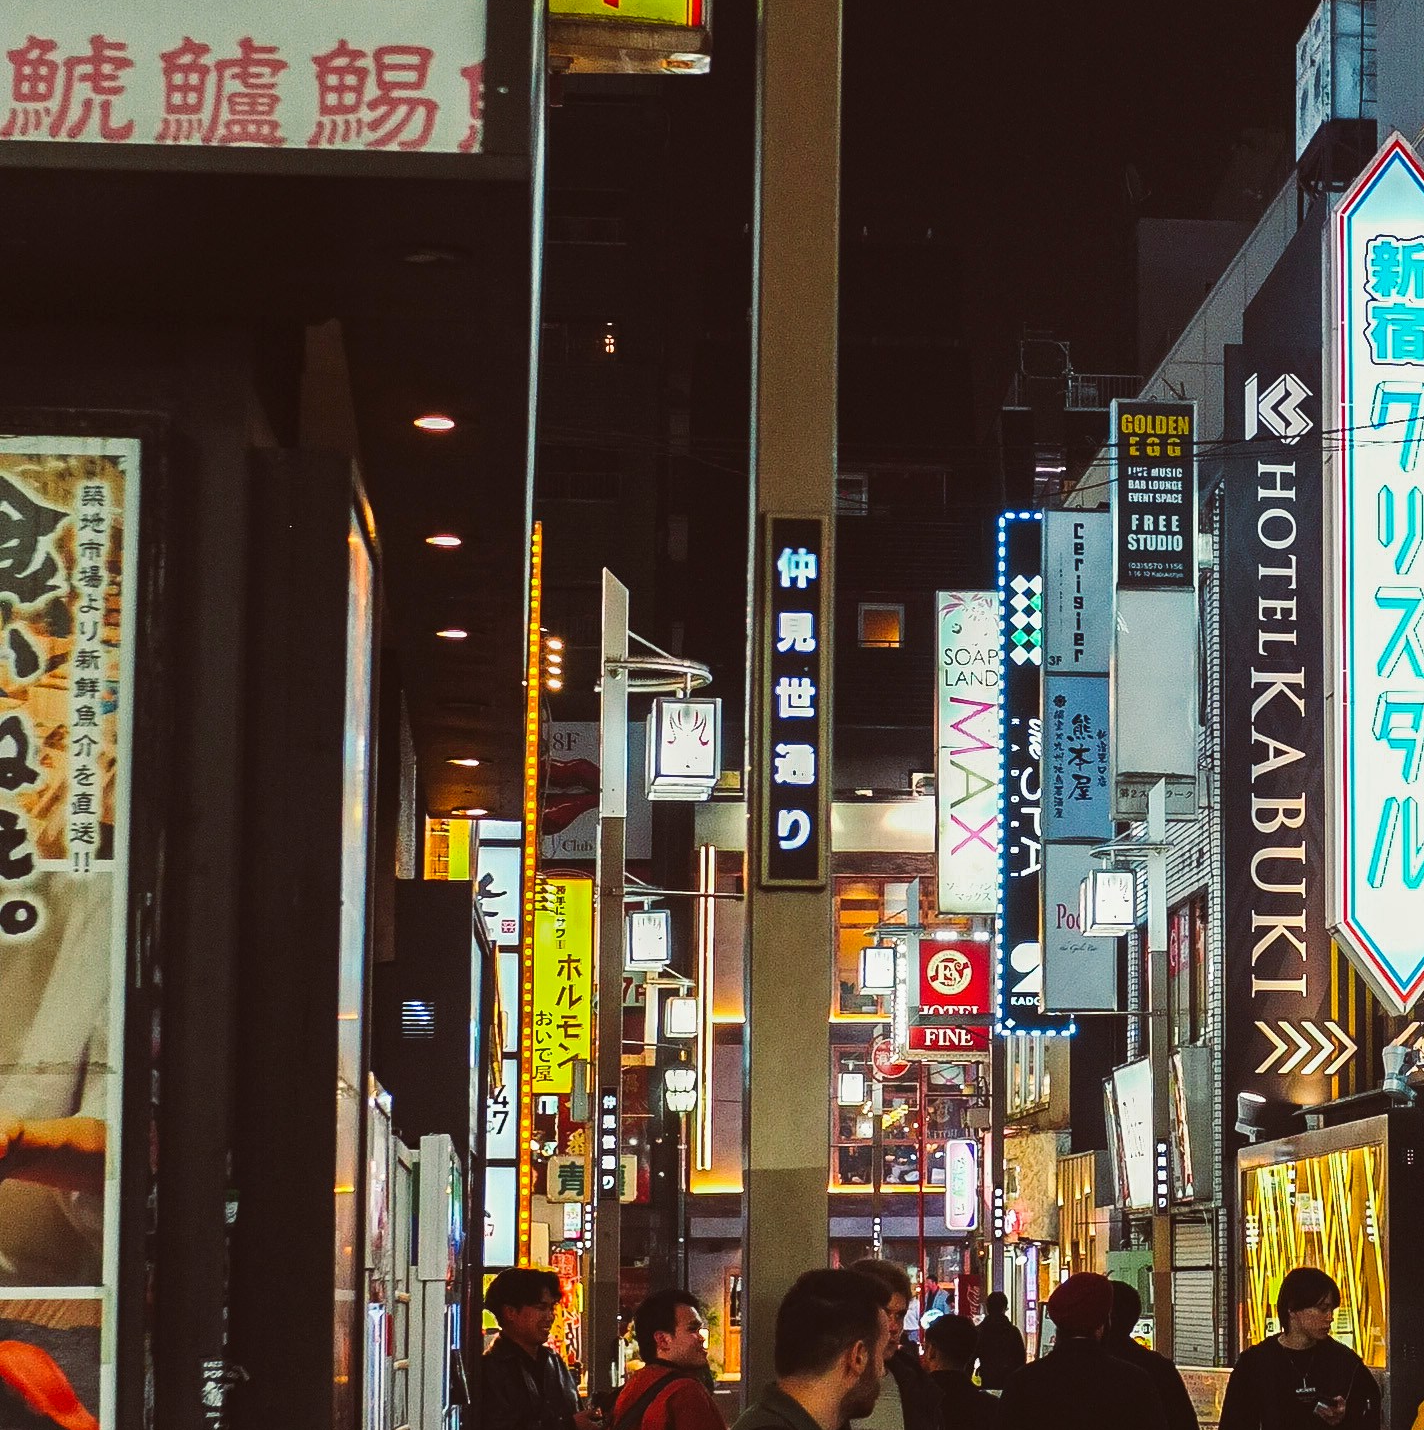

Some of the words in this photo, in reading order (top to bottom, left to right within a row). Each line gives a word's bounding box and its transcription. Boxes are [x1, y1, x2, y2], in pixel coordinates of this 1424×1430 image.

[1121, 414, 1190, 435] GOLDEN
[1129, 437, 1182, 457] EGG
[1151, 466, 1183, 478] MUSIC
[1149, 479, 1183, 491] LOUNGE
[1128, 492, 1153, 503] EVENT
[1155, 492, 1183, 503] SPACE
[1131, 514, 1180, 531] FREE
[1127, 534, 1183, 552] STUDIO
[1257, 460, 1297, 656] HOTEL
[944, 648, 999, 666] SOAP
[1048, 655, 1063, 666] 3F
[944, 670, 999, 686] LAND
[775, 546, 818, 852] 仲見世通り
[553, 732, 580, 752] 8F
[1067, 714, 1095, 800] 熊本屋
[950, 696, 998, 856] MAX
[1251, 666, 1308, 999] KABUKI
[555, 953, 583, 1070] ホルモン
[532, 1010, 554, 1083] おいで屋
[924, 1027, 974, 1047] FINE
